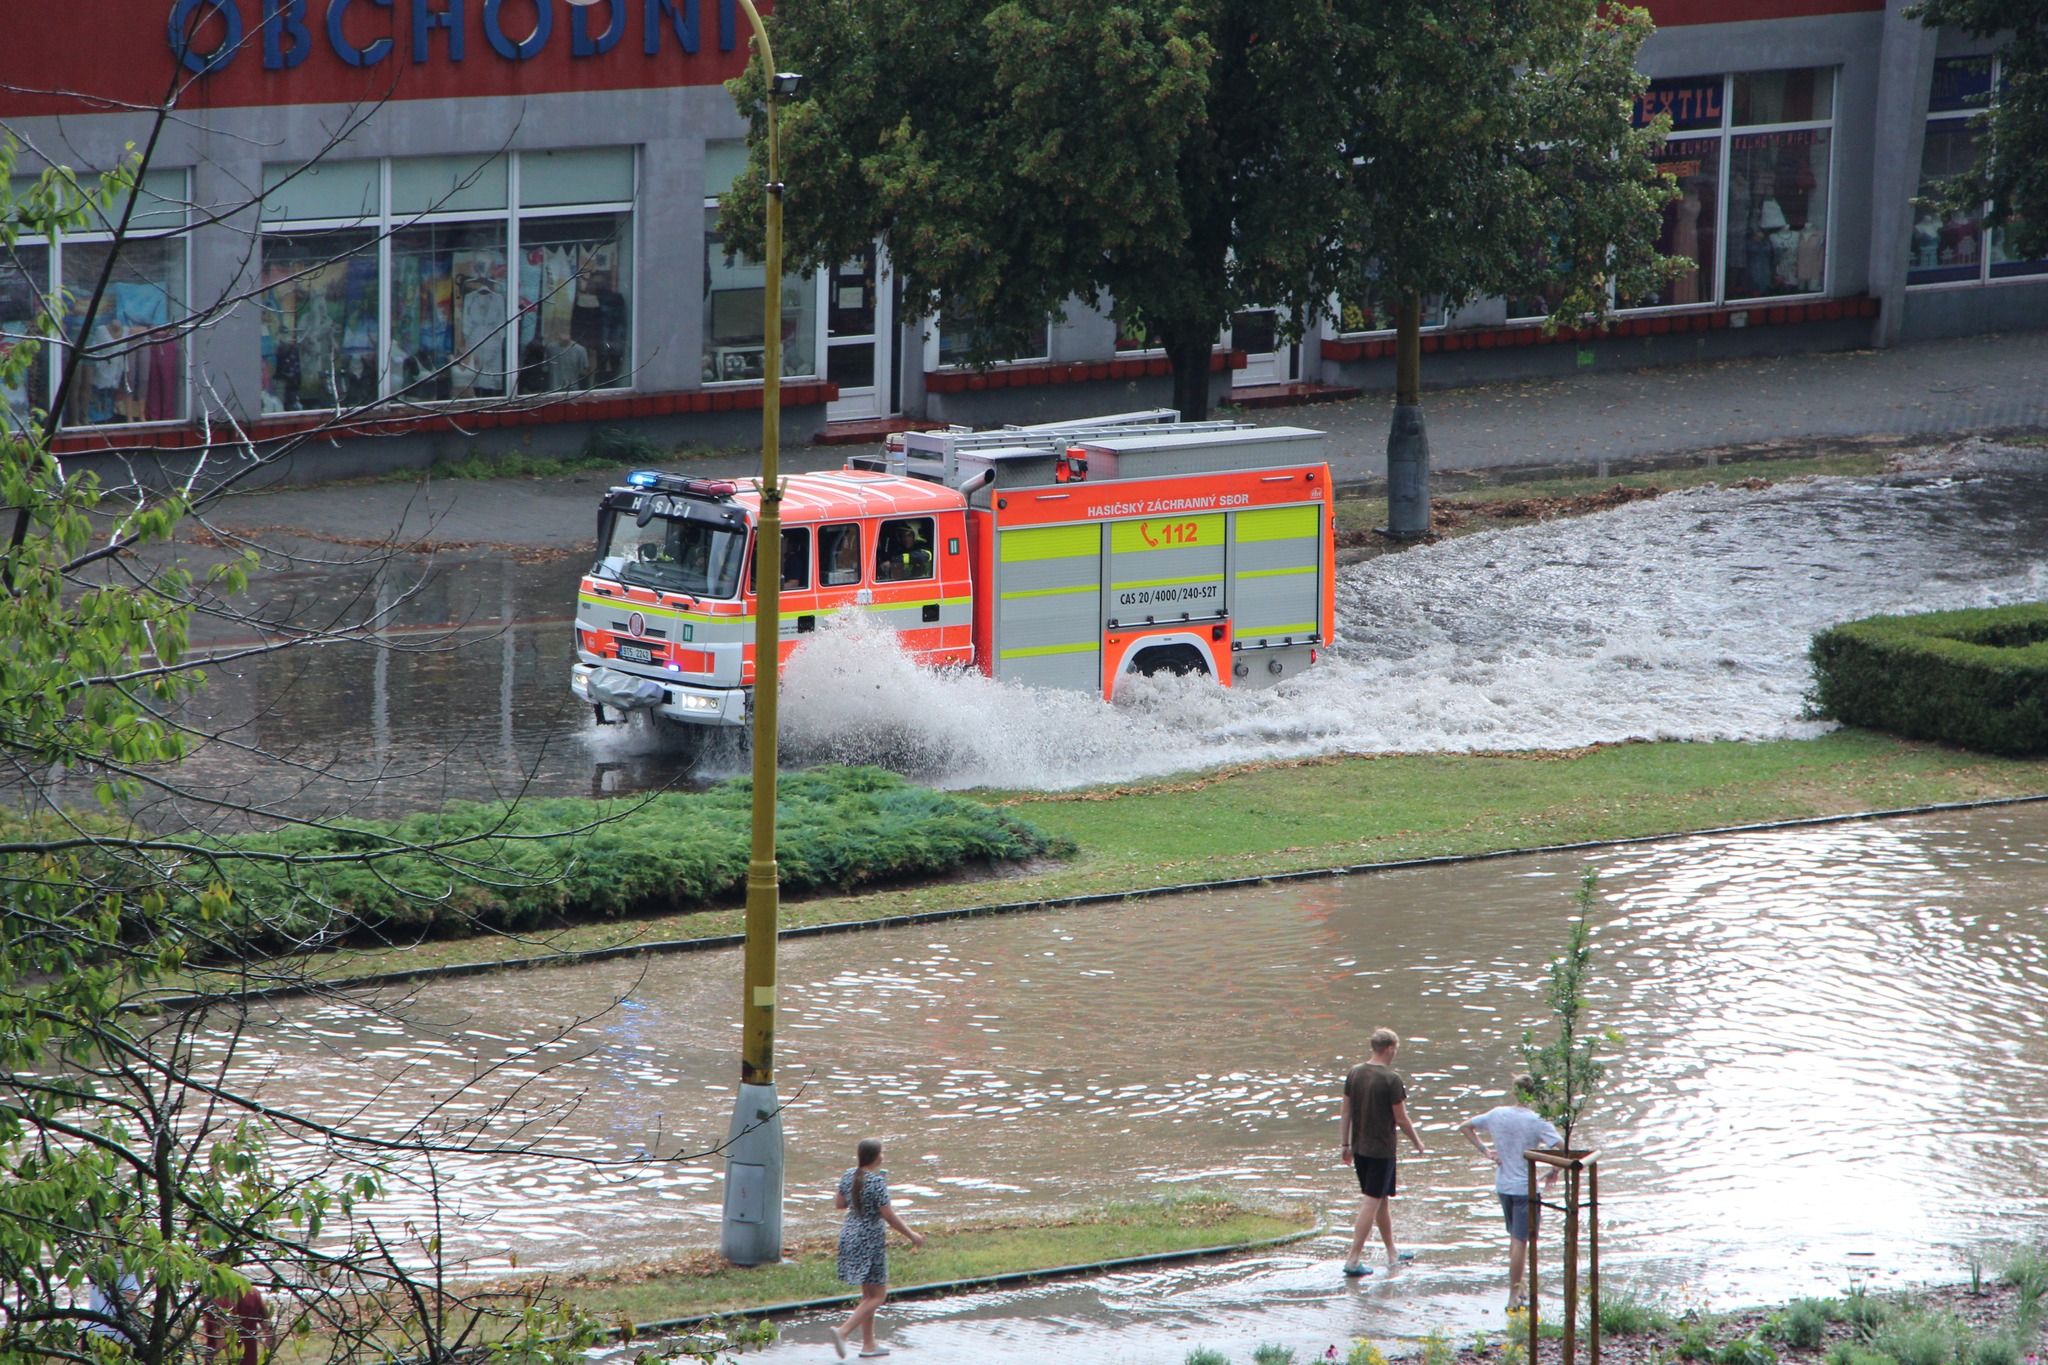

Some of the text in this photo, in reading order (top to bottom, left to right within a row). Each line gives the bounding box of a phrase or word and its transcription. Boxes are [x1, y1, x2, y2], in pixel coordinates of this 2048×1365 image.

[631, 496, 691, 518] HSIČI
[1087, 493, 1249, 517] HASIČSKÝ ZÁCHRANNÝ SBOR
[1162, 522, 1198, 544] 112
[1120, 585, 1217, 605] CAS 20/4000/240-S2T
